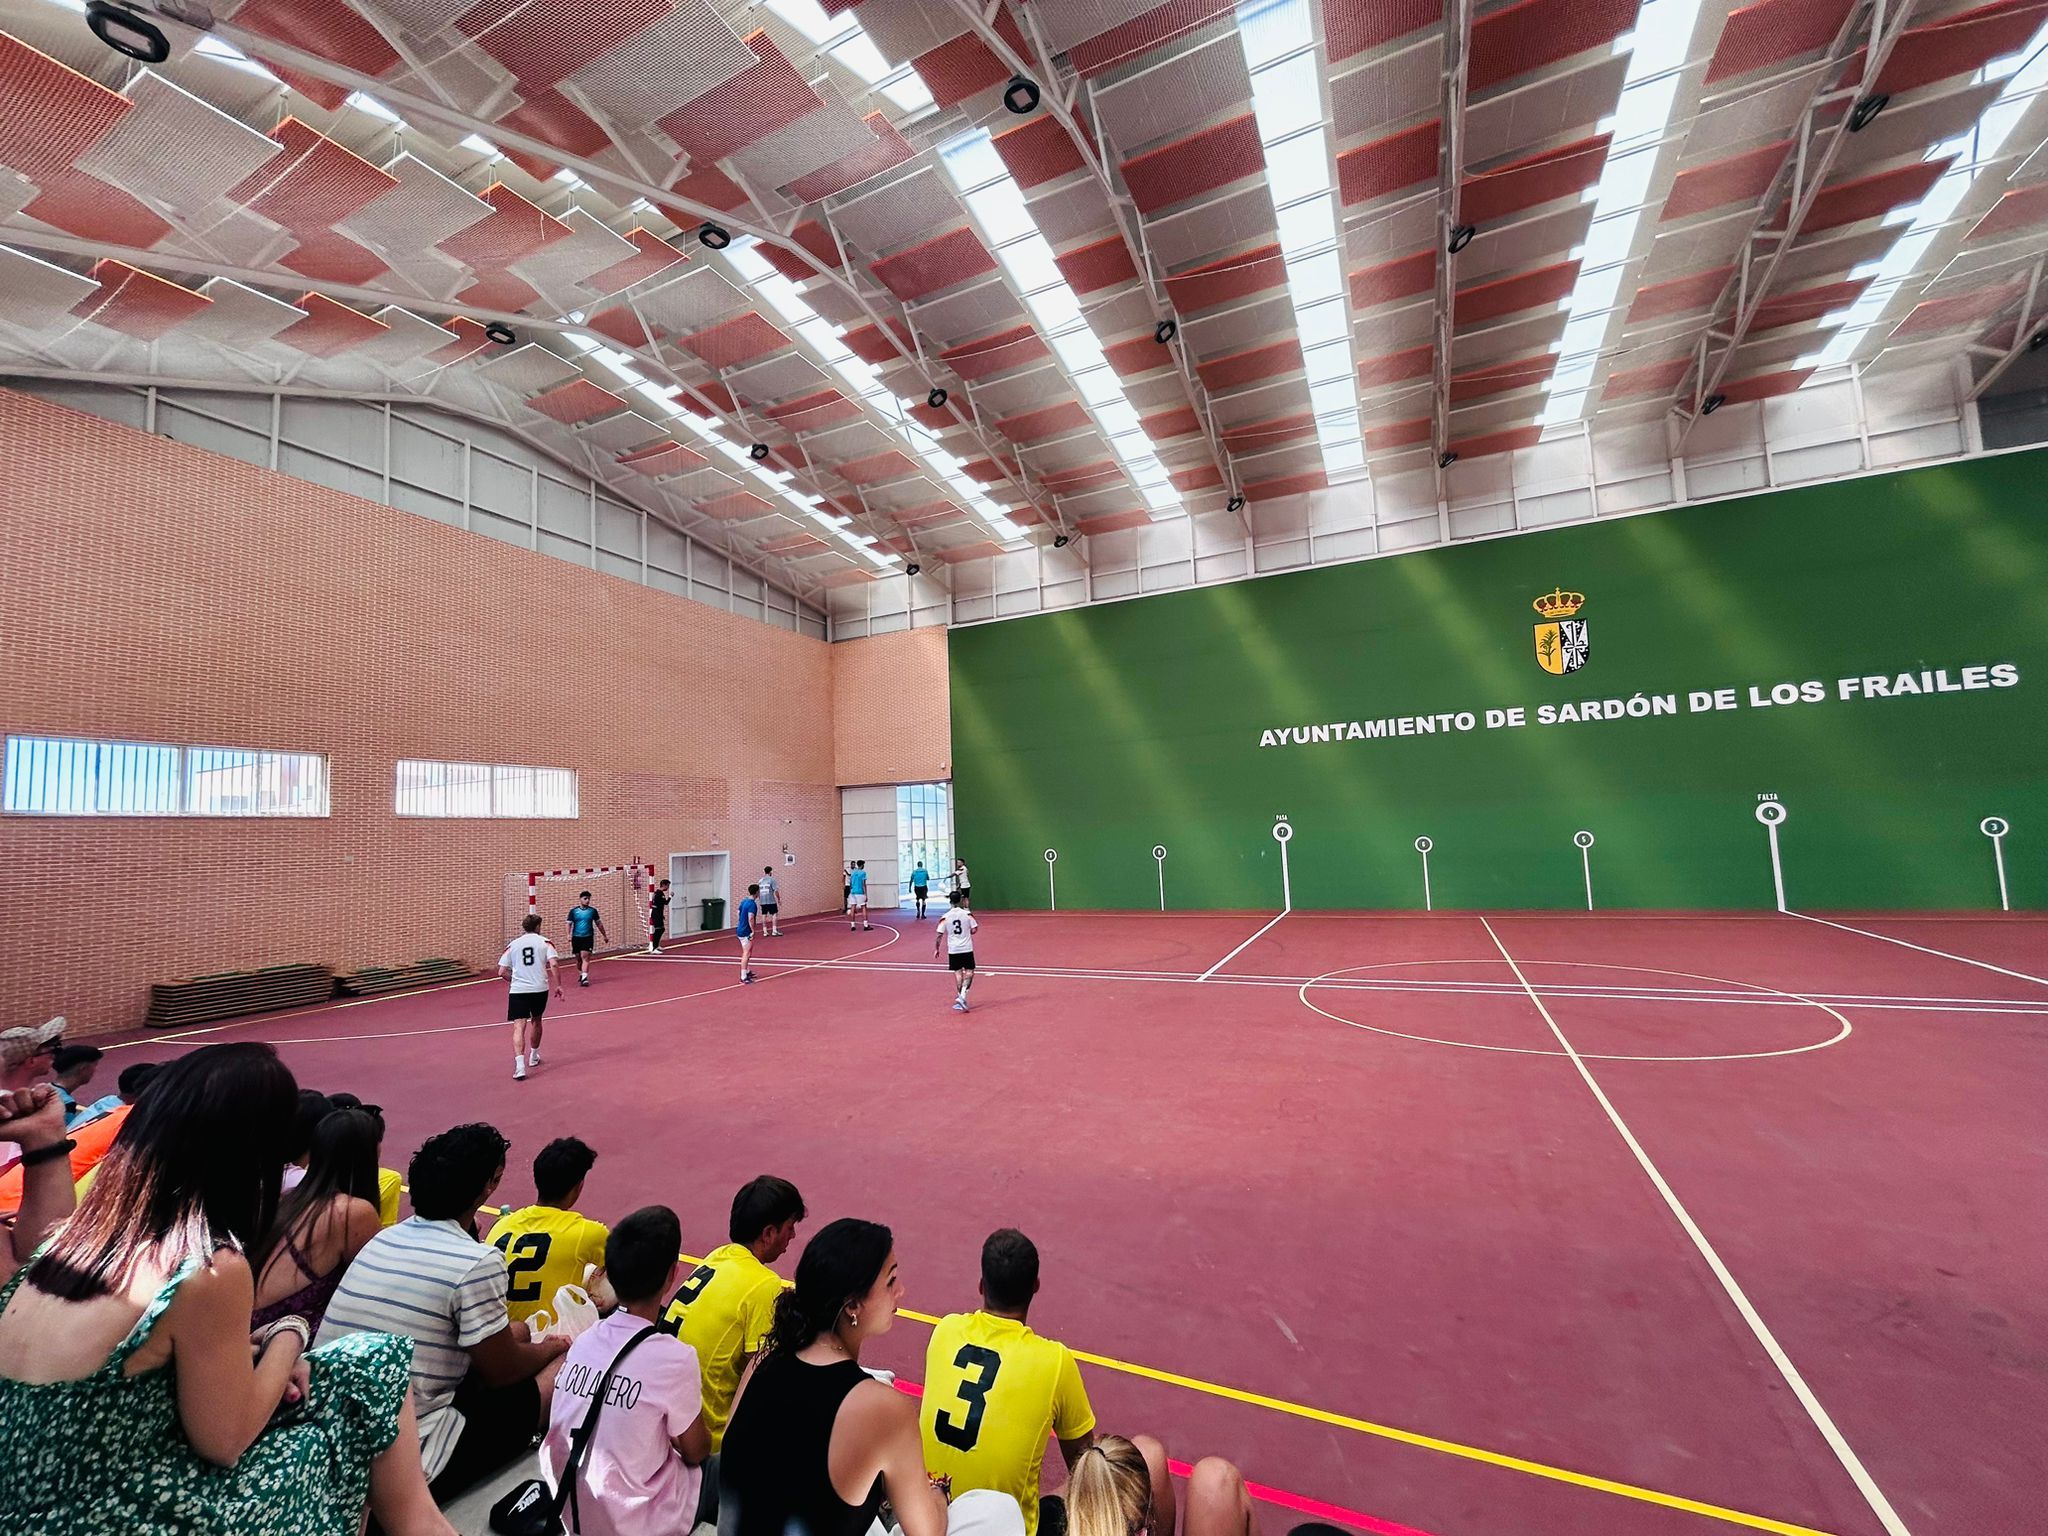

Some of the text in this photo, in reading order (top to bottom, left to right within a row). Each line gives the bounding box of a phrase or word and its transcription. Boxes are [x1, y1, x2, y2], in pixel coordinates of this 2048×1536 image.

[1258, 663, 2019, 747] AYUNTAMIENTO DE SARDÓN DE LOS FRAILES
[1757, 793, 1778, 801] FALTA
[1990, 823, 1998, 831] 3
[953, 919, 963, 935] 3
[522, 946, 535, 966] 8
[494, 1231, 552, 1302] 2
[934, 1343, 1001, 1453] 3
[517, 1488, 541, 1513] NIKE
